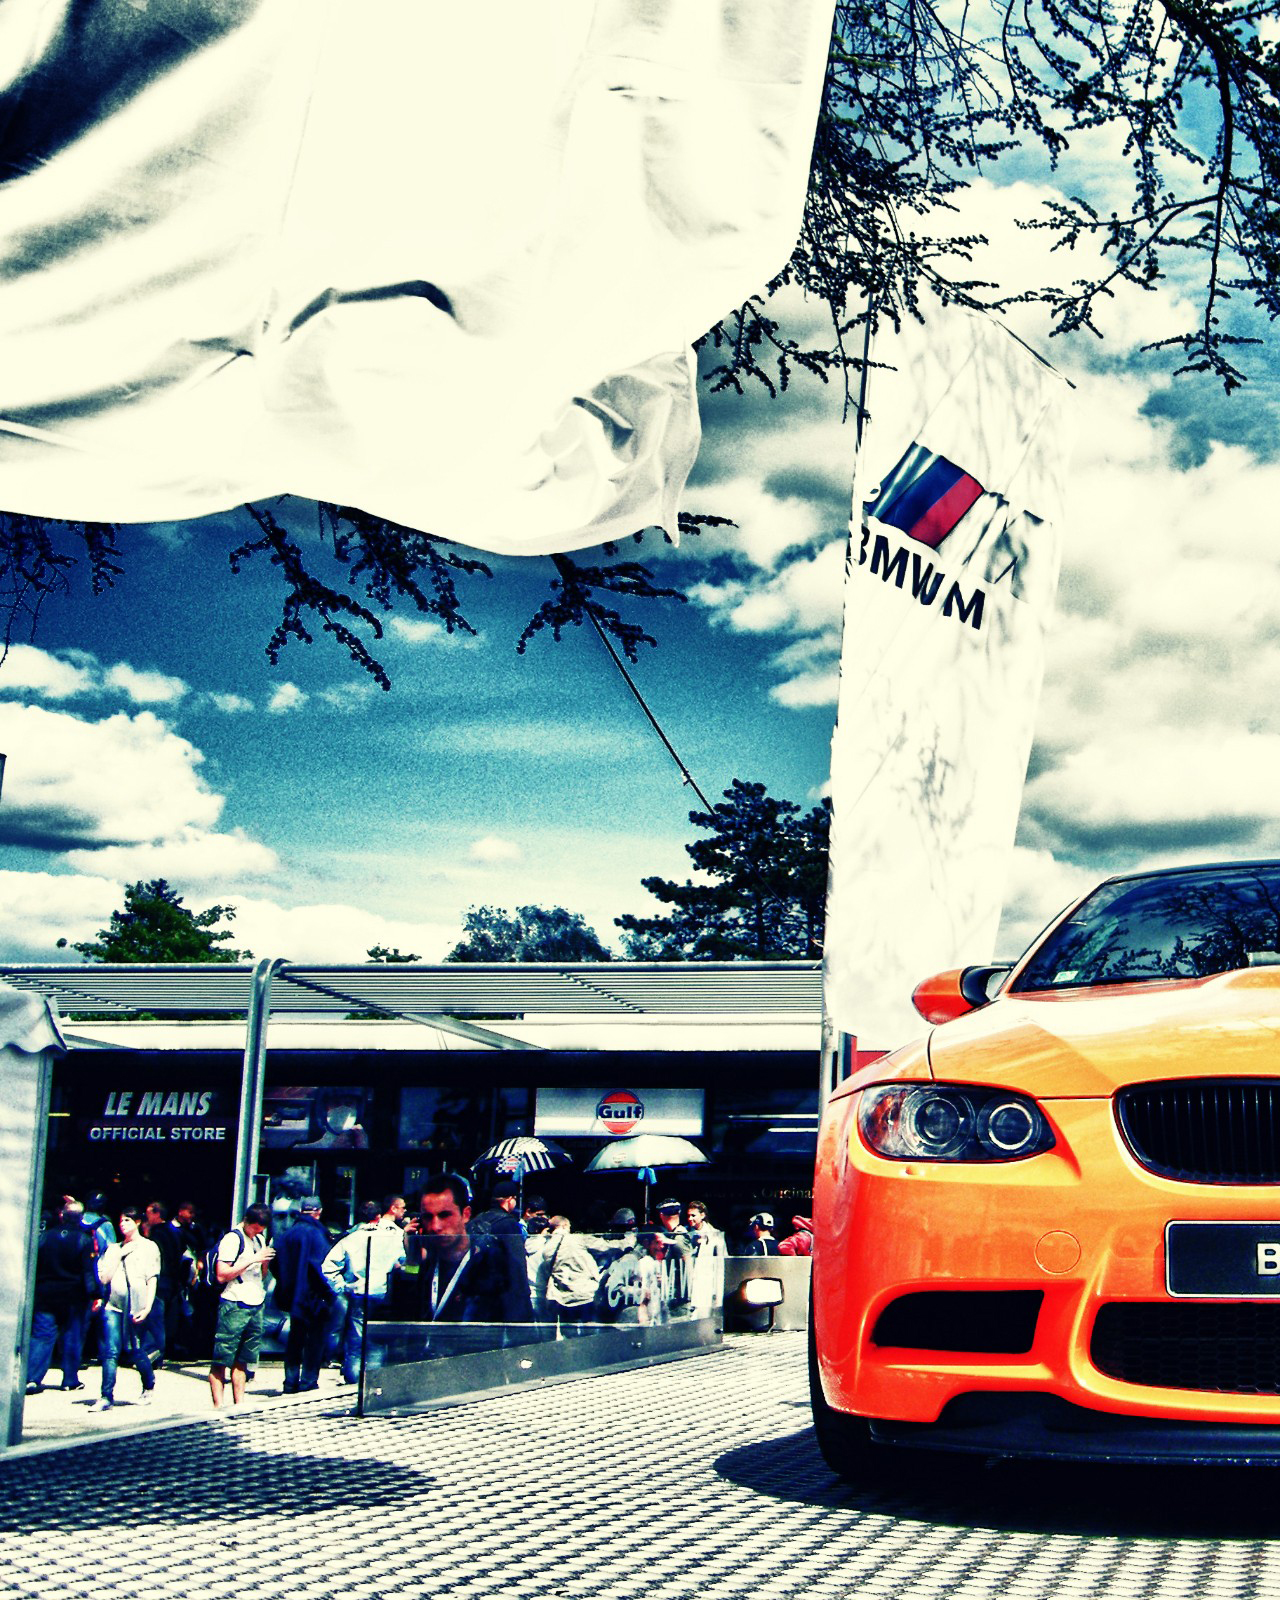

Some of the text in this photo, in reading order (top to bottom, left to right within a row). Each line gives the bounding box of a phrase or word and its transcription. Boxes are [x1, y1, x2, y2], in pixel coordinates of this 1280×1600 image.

[943, 580, 986, 630] M
[105, 1091, 212, 1116] LE MANS
[598, 1105, 642, 1119] Gulf
[90, 1127, 226, 1140] OFFICIAL STORE
[761, 1187, 815, 1199] Origina
